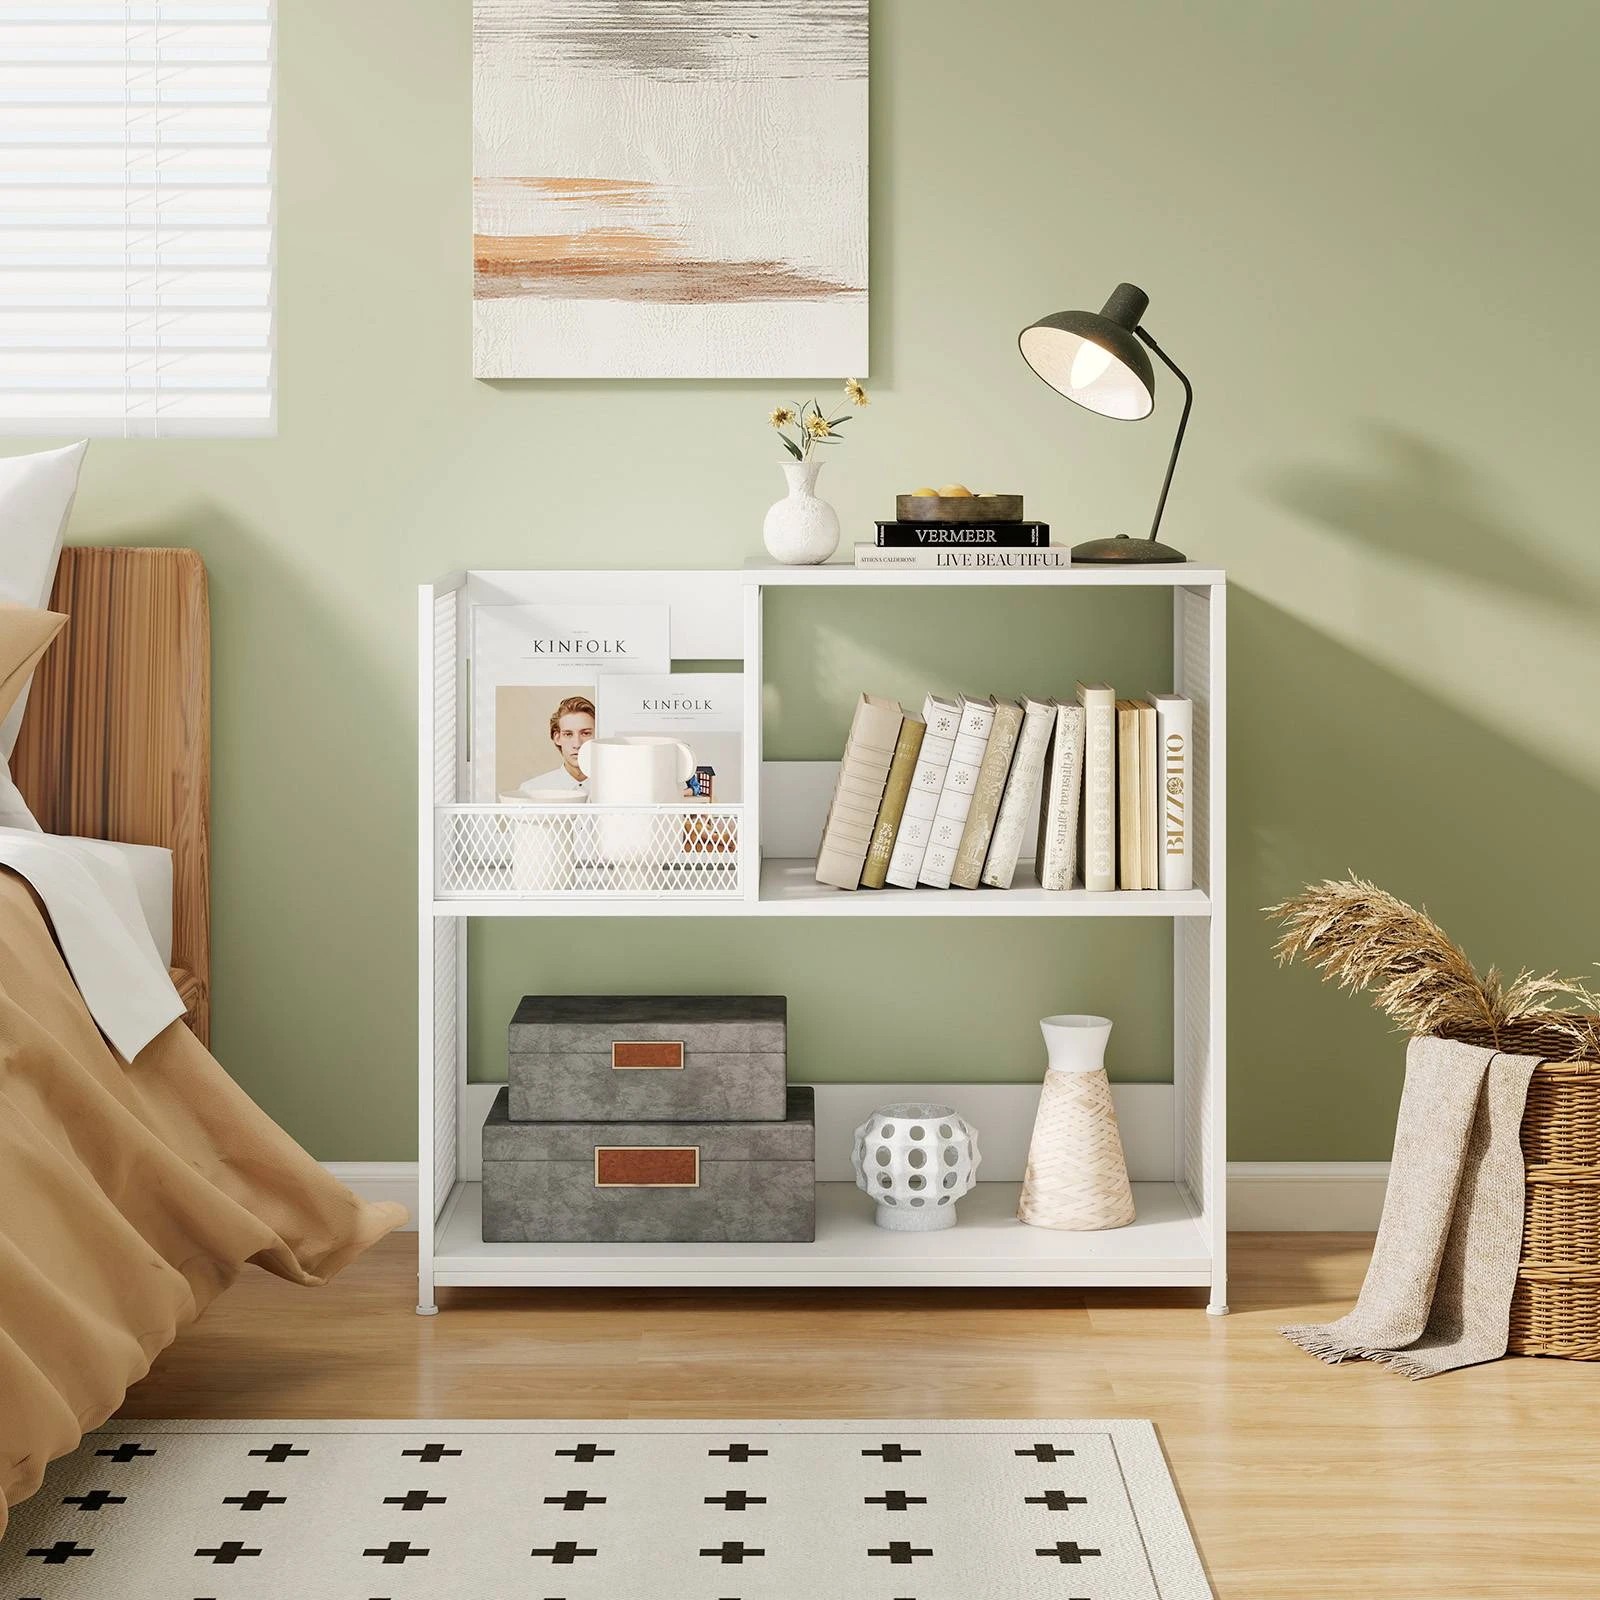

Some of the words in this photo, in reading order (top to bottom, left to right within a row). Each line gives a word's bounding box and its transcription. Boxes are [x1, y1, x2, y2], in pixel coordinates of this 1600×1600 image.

[915, 529, 997, 543] VERMEER
[937, 553, 972, 566] LIVE
[976, 553, 1064, 566] BEAUTIFUL
[533, 639, 627, 653] KINFOLK
[642, 699, 713, 711] KINFOLK
